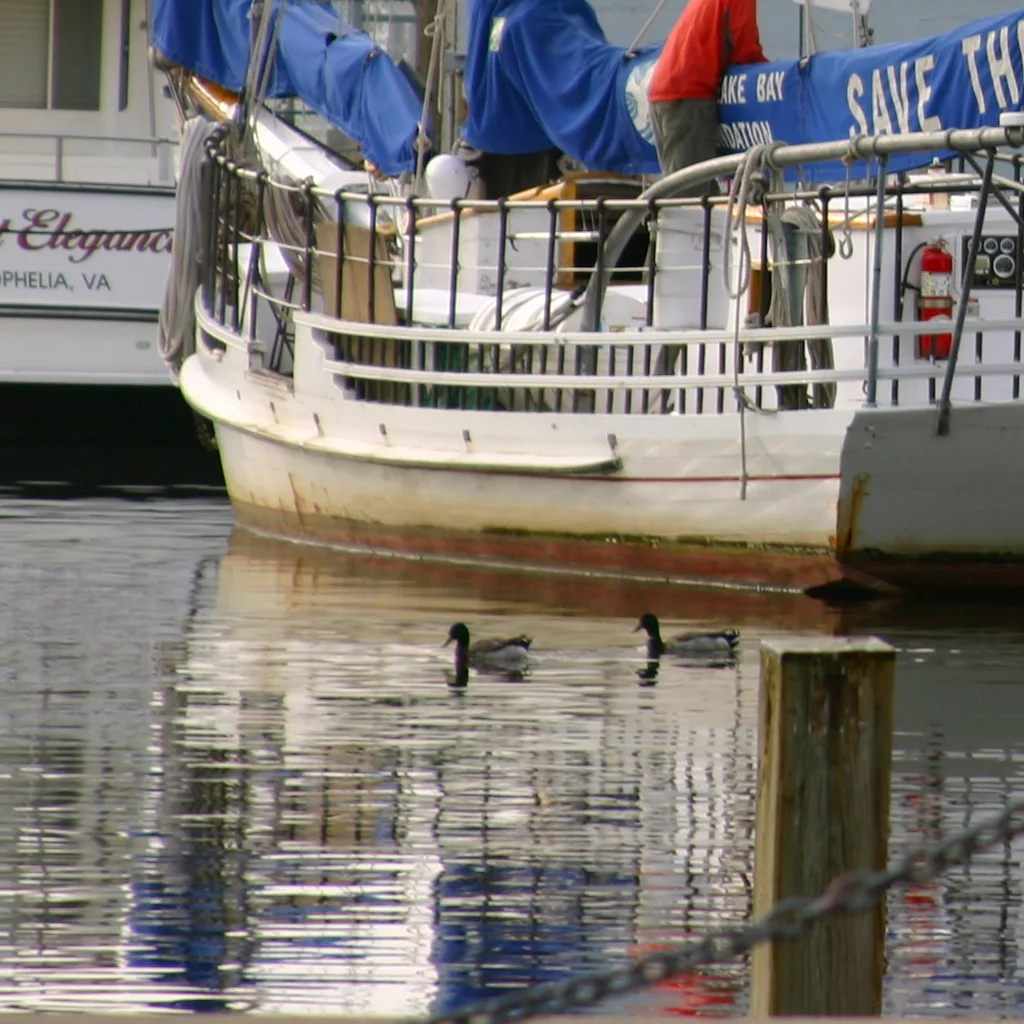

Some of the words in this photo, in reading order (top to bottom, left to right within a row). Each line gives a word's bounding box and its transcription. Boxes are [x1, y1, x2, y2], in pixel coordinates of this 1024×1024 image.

[717, 74, 747, 105] AKE
[756, 71, 785, 103] BAY
[847, 55, 942, 137] SAVE
[82, 273, 112, 292] VA
